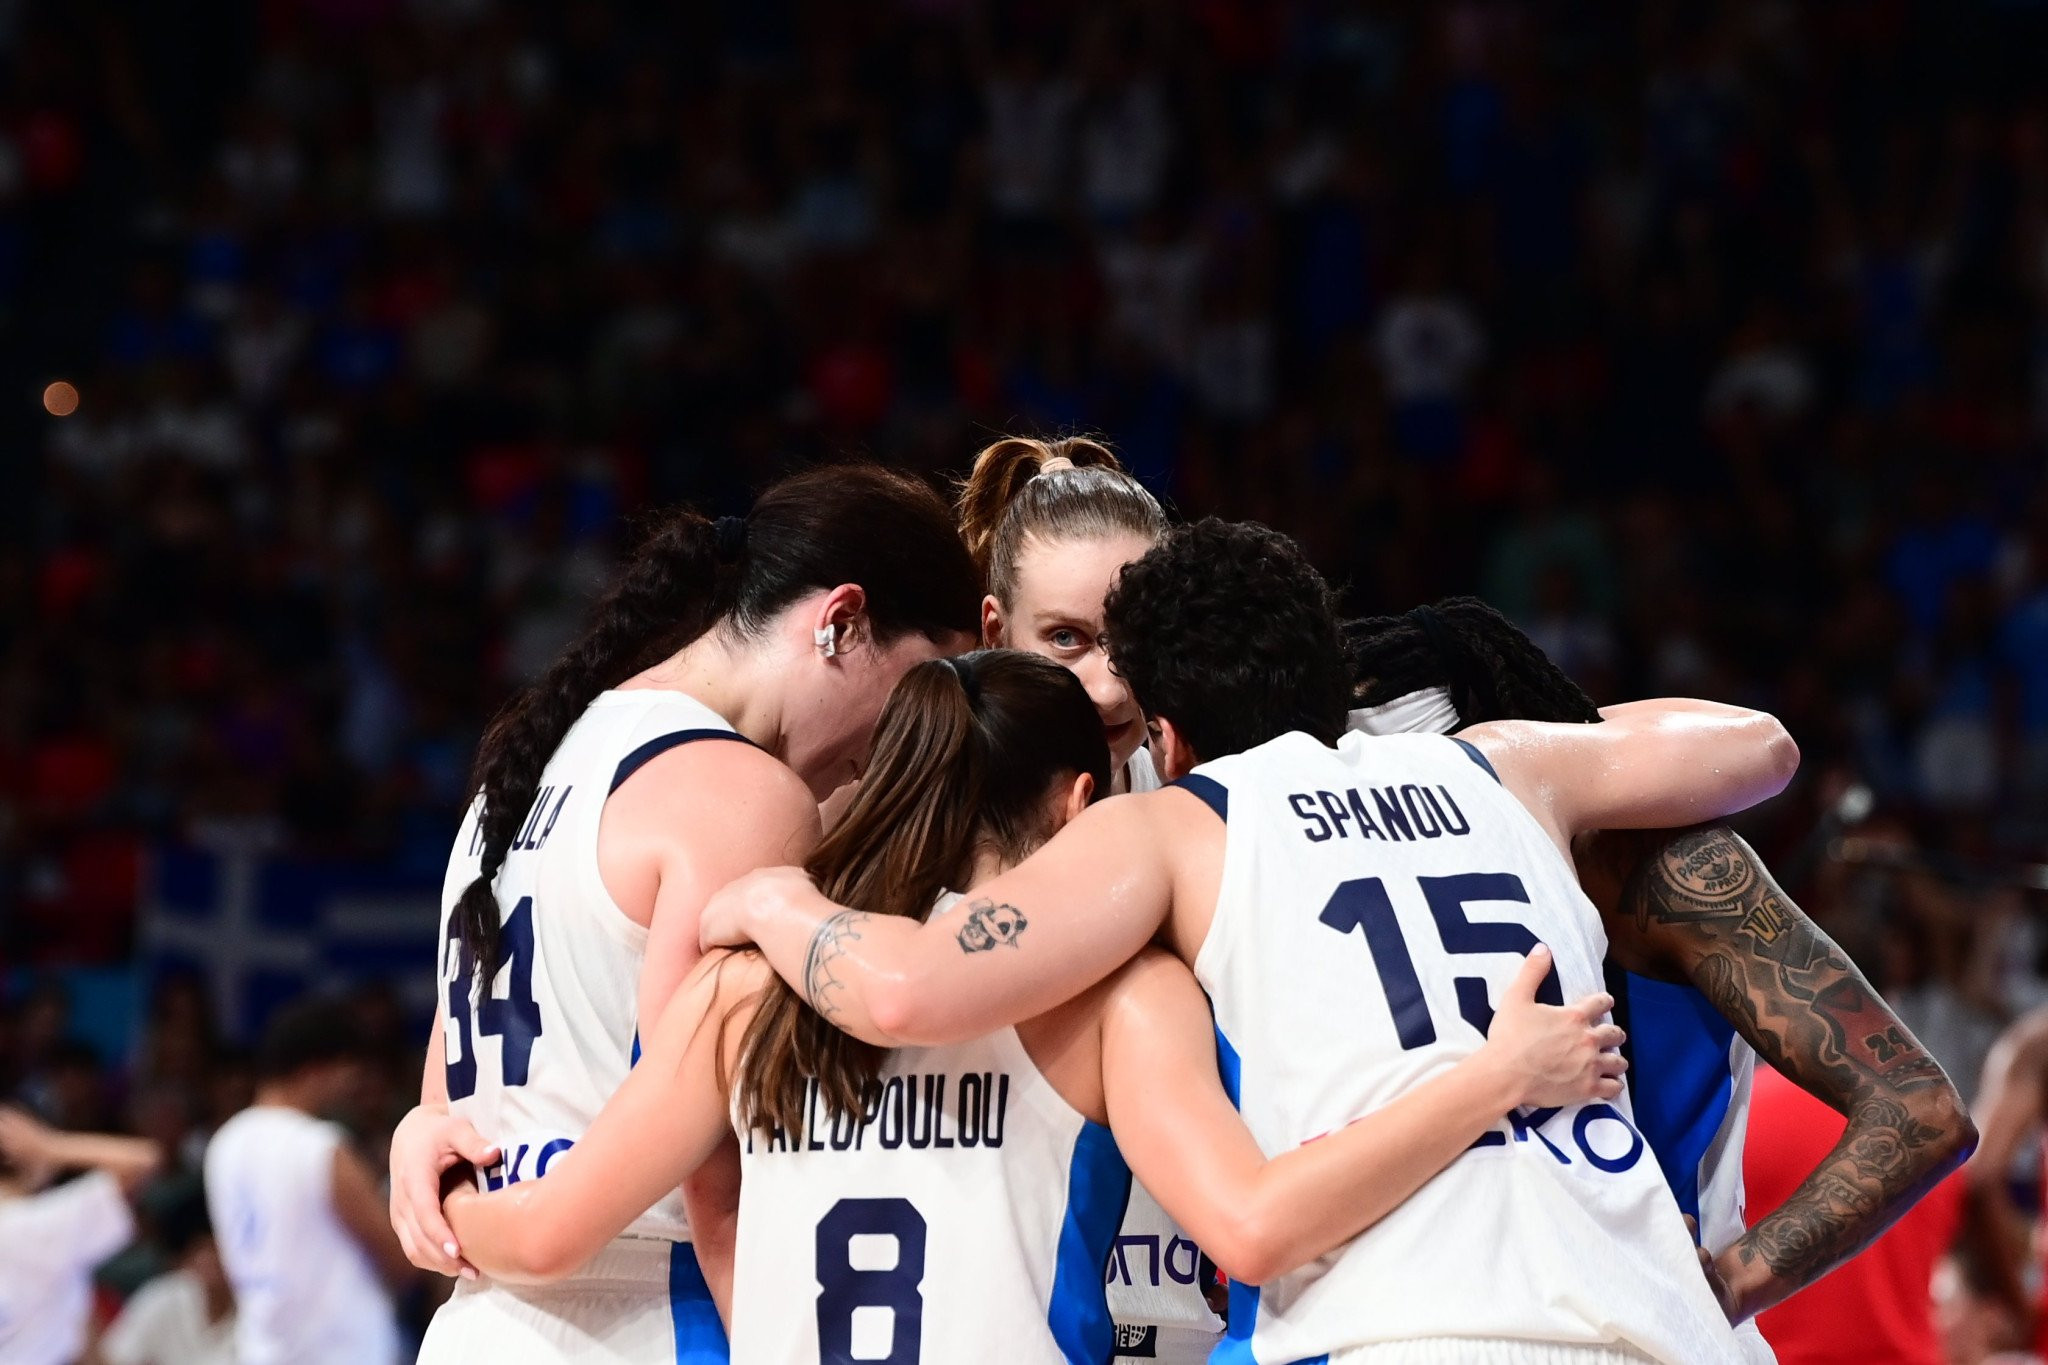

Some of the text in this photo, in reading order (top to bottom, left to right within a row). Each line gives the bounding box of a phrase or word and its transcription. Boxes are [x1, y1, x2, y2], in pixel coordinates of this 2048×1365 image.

[1288, 784, 1471, 843] SPANOU
[444, 896, 542, 1102] 34
[1318, 872, 1564, 1051] 15
[815, 1197, 928, 1365] 8
